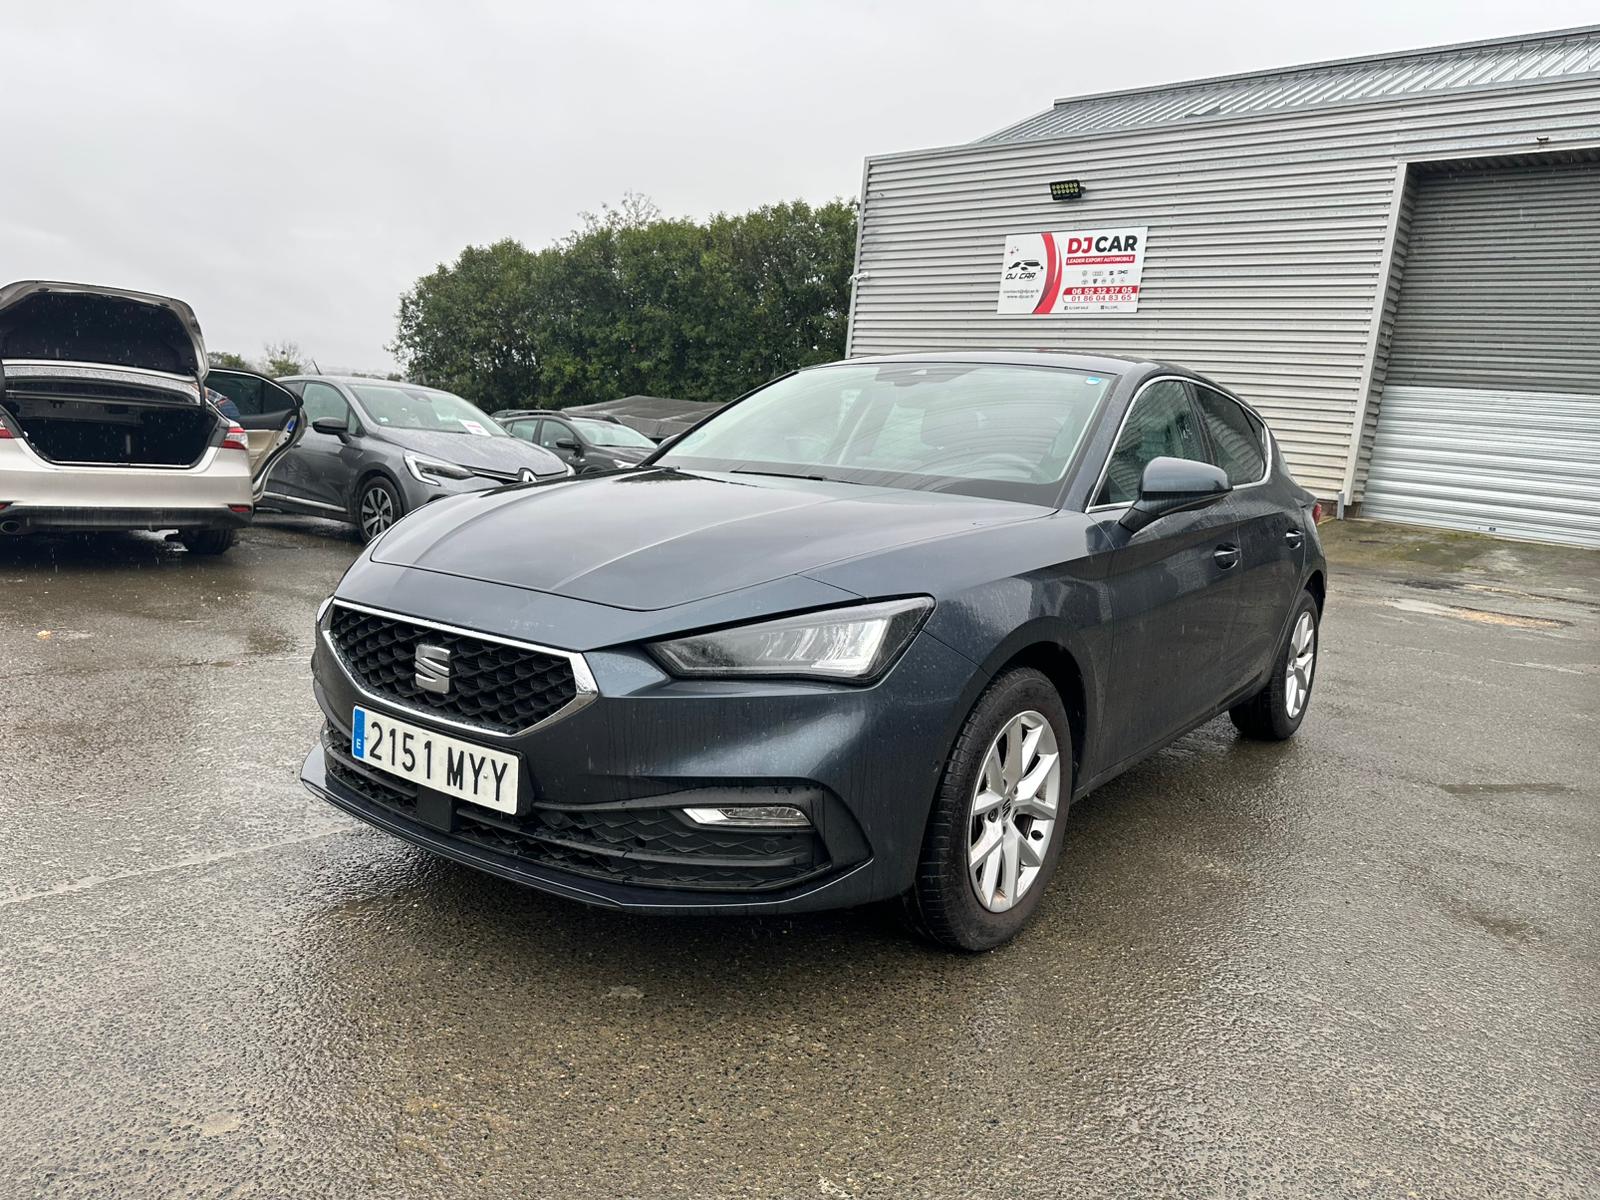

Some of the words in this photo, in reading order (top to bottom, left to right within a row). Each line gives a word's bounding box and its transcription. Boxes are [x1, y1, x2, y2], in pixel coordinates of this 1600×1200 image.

[1067, 237, 1093, 254] DJ
[1095, 235, 1138, 253] CAR
[1019, 272, 1036, 280] CAR
[1121, 286, 1133, 294] 05
[356, 738, 361, 749] E
[369, 721, 432, 780] 2151
[446, 746, 508, 802] MYY
